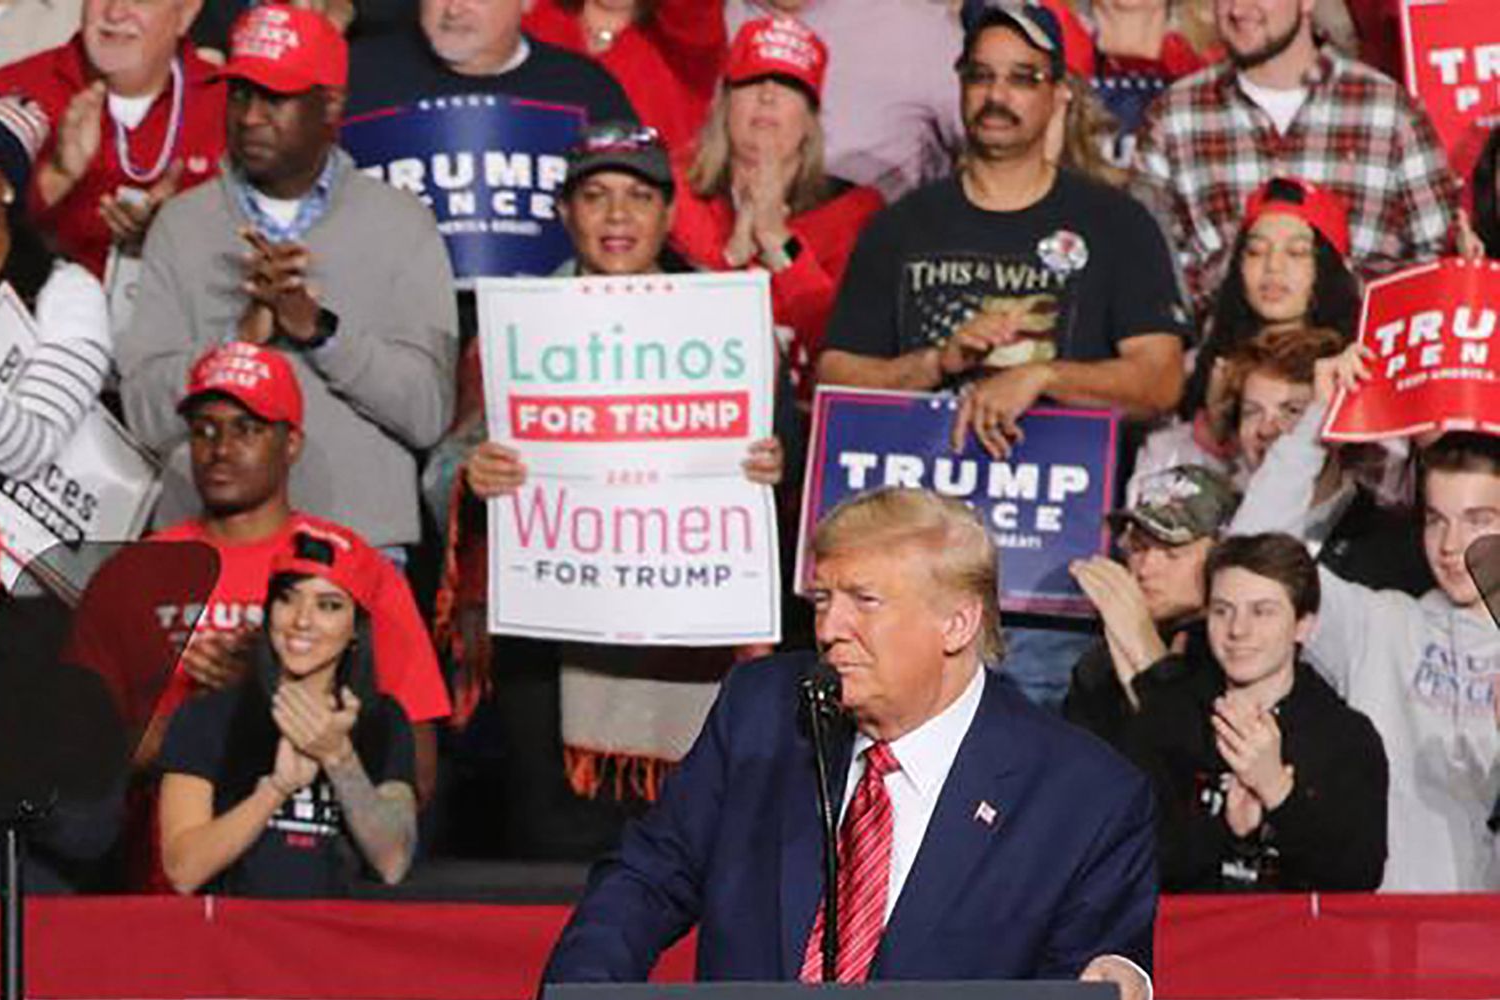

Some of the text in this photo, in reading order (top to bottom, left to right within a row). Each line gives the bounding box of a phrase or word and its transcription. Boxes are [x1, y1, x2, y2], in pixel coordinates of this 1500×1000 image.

[420, 191, 556, 219] NCE
[908, 261, 972, 292] THIS
[1375, 305, 1497, 357] TRU
[506, 324, 746, 382] Latinos
[1385, 342, 1488, 379] PEN
[518, 401, 741, 433] FOR TRUMP
[840, 452, 1089, 501] TRUMP
[512, 486, 753, 553] Women
[536, 561, 731, 587] FOR TRUMP
[156, 602, 264, 630] TRU
